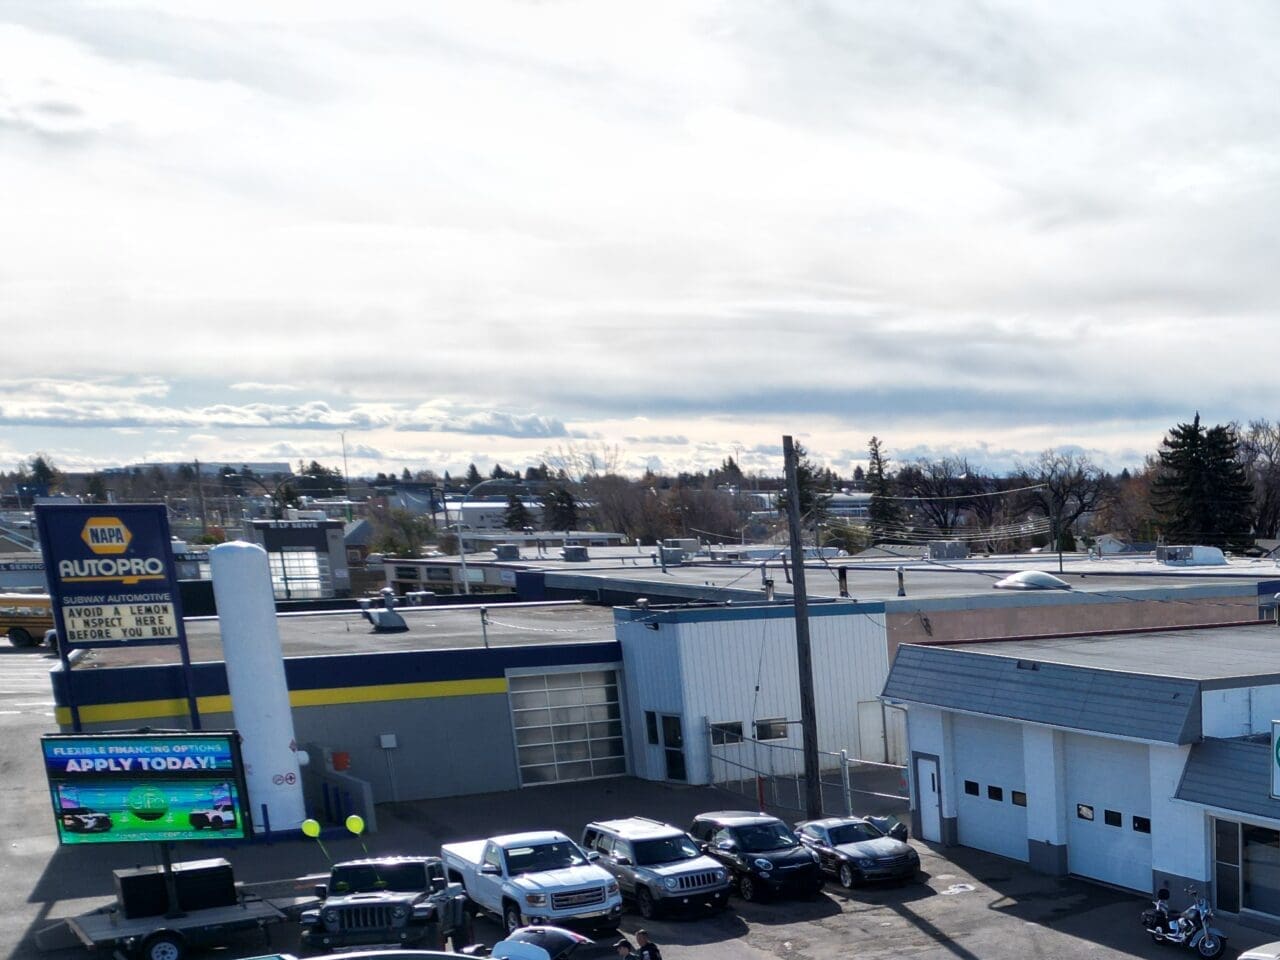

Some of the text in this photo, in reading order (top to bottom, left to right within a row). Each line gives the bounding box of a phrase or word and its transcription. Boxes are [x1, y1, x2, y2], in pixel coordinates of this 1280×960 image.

[90, 527, 124, 544] NAPA
[59, 557, 164, 577] AUTOPRO
[63, 593, 171, 604] SUBWAY AUTOMOTIVE
[68, 605, 169, 618] AVOID A LEMON
[135, 616, 165, 626] HERE
[69, 626, 172, 640] BEFORE YOU BUY
[53, 744, 222, 756] FLEXIBLE FINANCING OPTIONS
[66, 756, 216, 773] APPLY TODAY!
